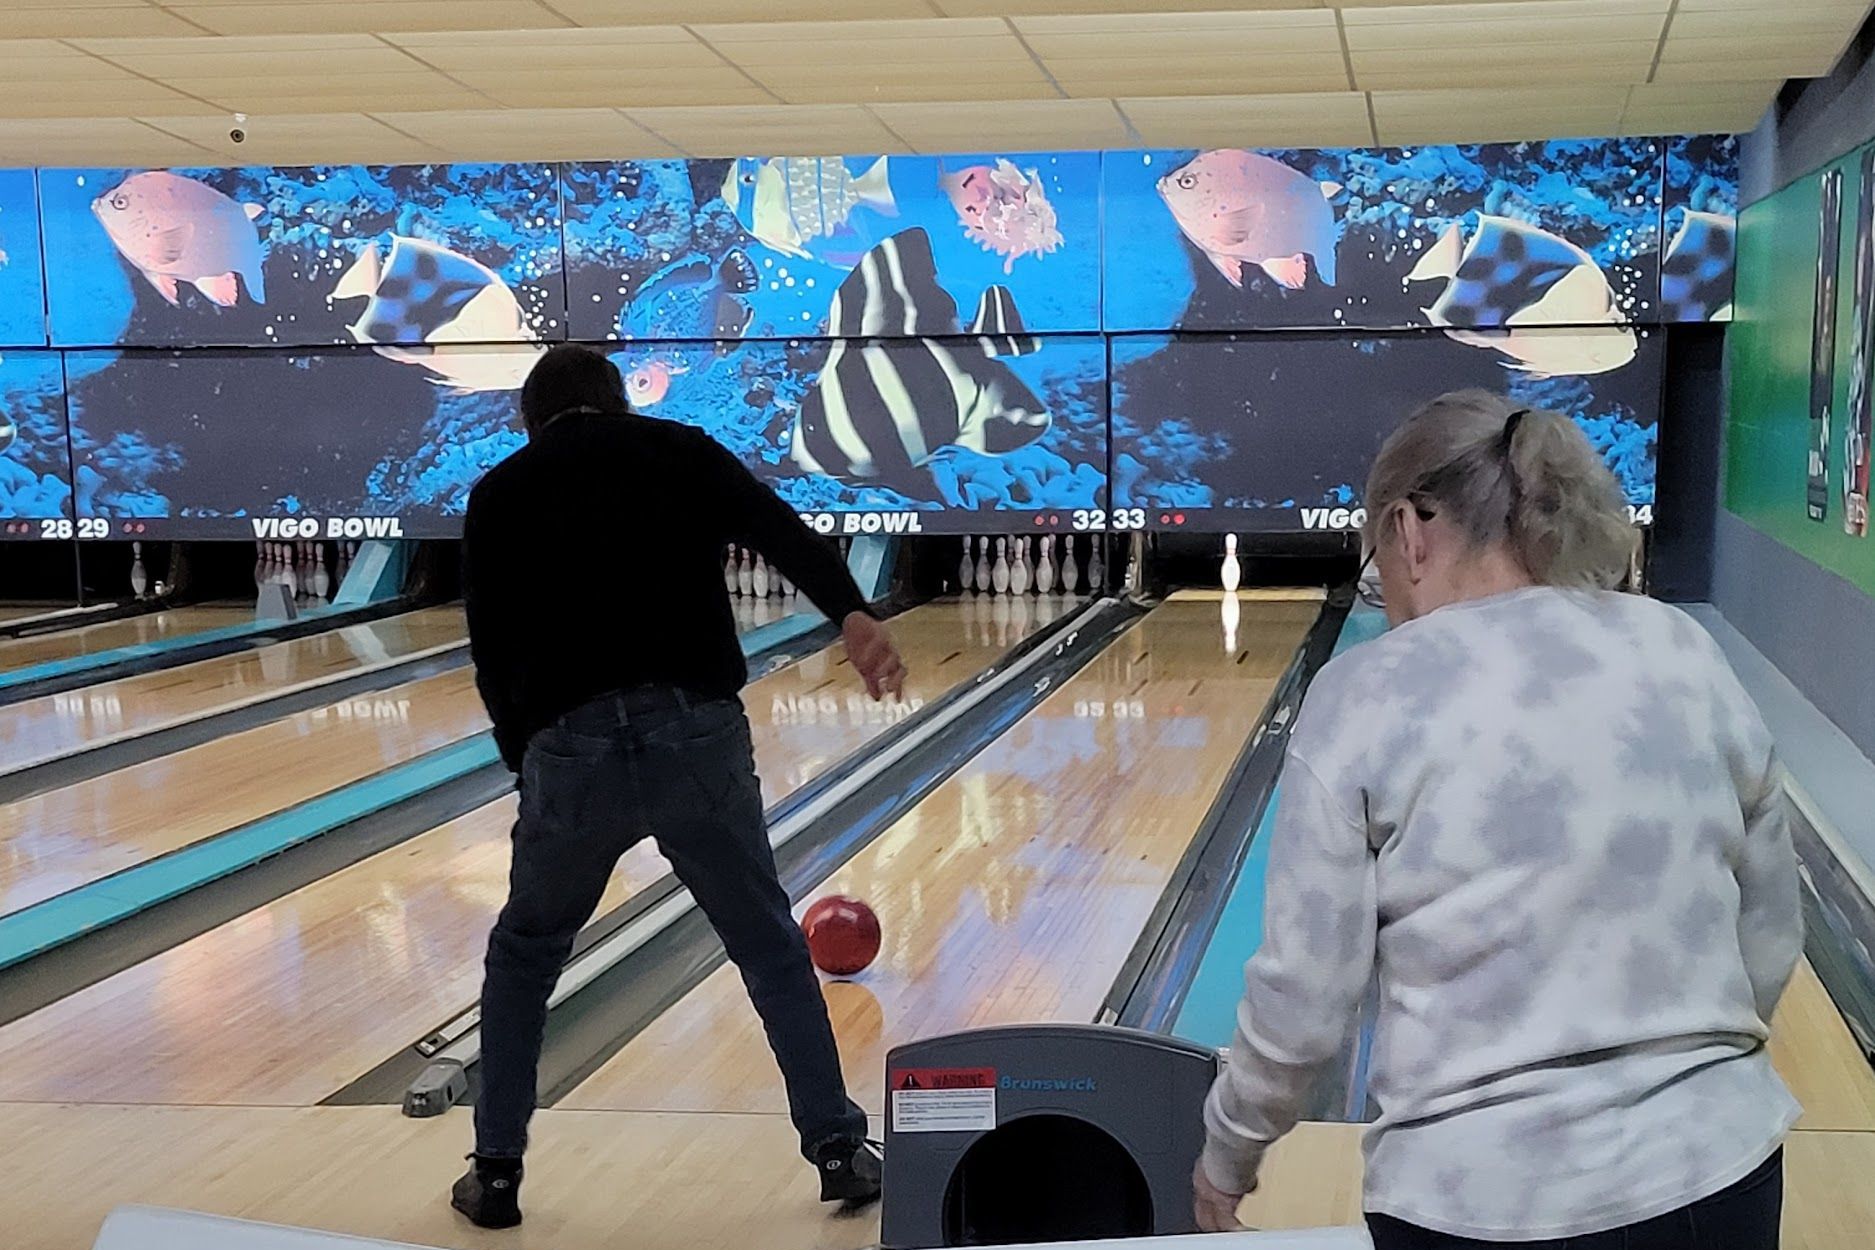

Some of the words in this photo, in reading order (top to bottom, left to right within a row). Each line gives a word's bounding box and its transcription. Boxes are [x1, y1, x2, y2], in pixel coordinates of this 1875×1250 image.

[77, 518, 109, 539] 29
[252, 518, 319, 538] VIGO
[327, 518, 403, 538] BOWL
[843, 512, 922, 533] BOWL
[1072, 509, 1106, 531] 32
[1112, 508, 1146, 530] 33
[1300, 507, 1368, 529] VIGO
[41, 519, 73, 540] 28
[1000, 1075, 1096, 1091] Brunswick
